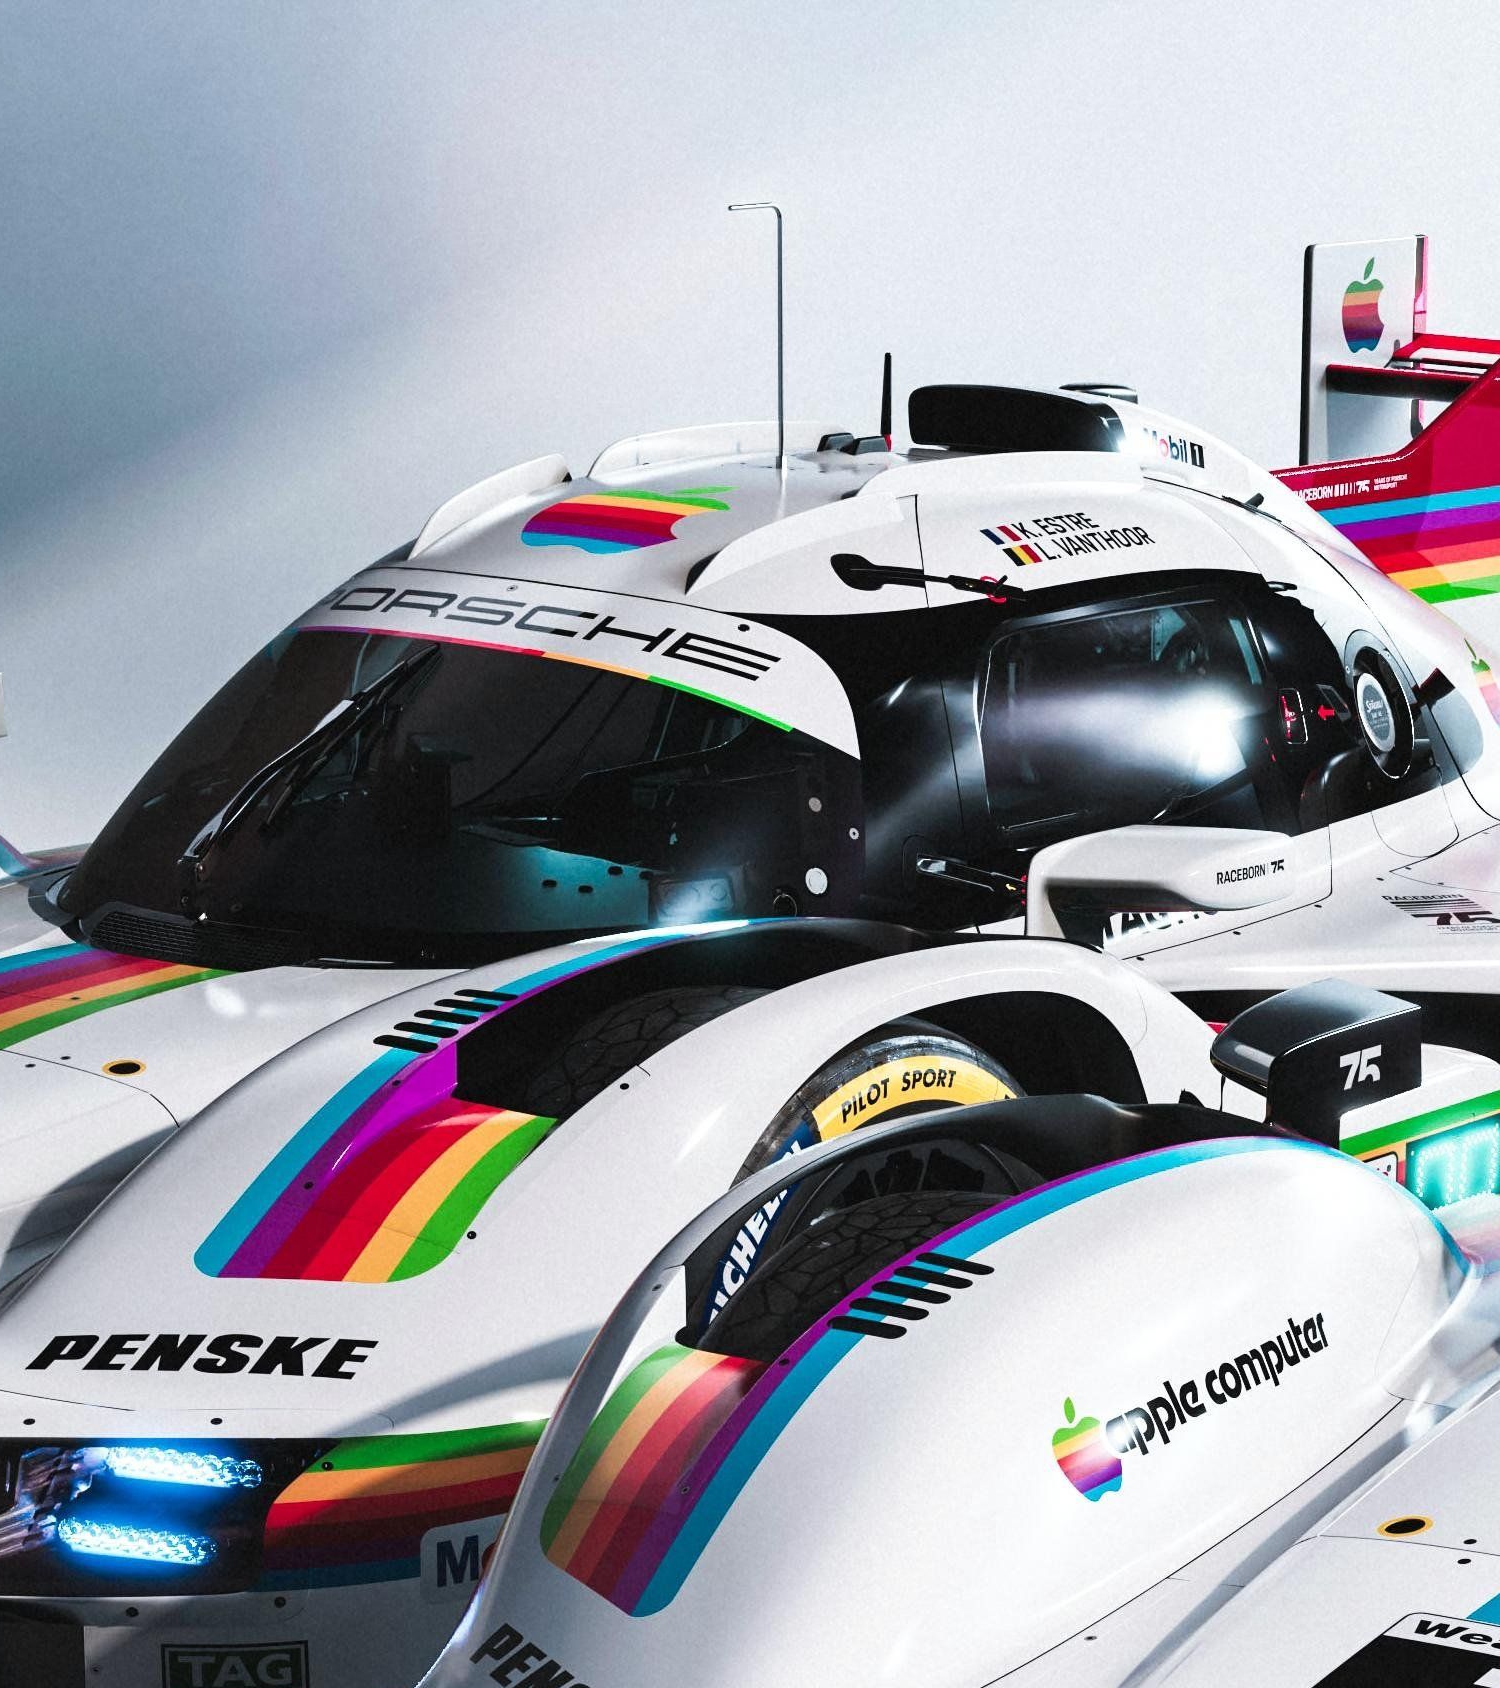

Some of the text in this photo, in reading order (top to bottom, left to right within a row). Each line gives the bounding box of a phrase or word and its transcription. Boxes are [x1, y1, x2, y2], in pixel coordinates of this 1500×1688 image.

[1035, 512, 1100, 537] ESTRE
[1058, 526, 1156, 556] VANTHOOR
[1216, 859, 1285, 885] RACEBORN 75
[1339, 1044, 1382, 1091] 75
[841, 1068, 957, 1124] PILOT SPORT
[25, 1332, 380, 1381] PENSKE
[1106, 1312, 1330, 1456] apple computer
[177, 1653, 293, 1688] TAG
